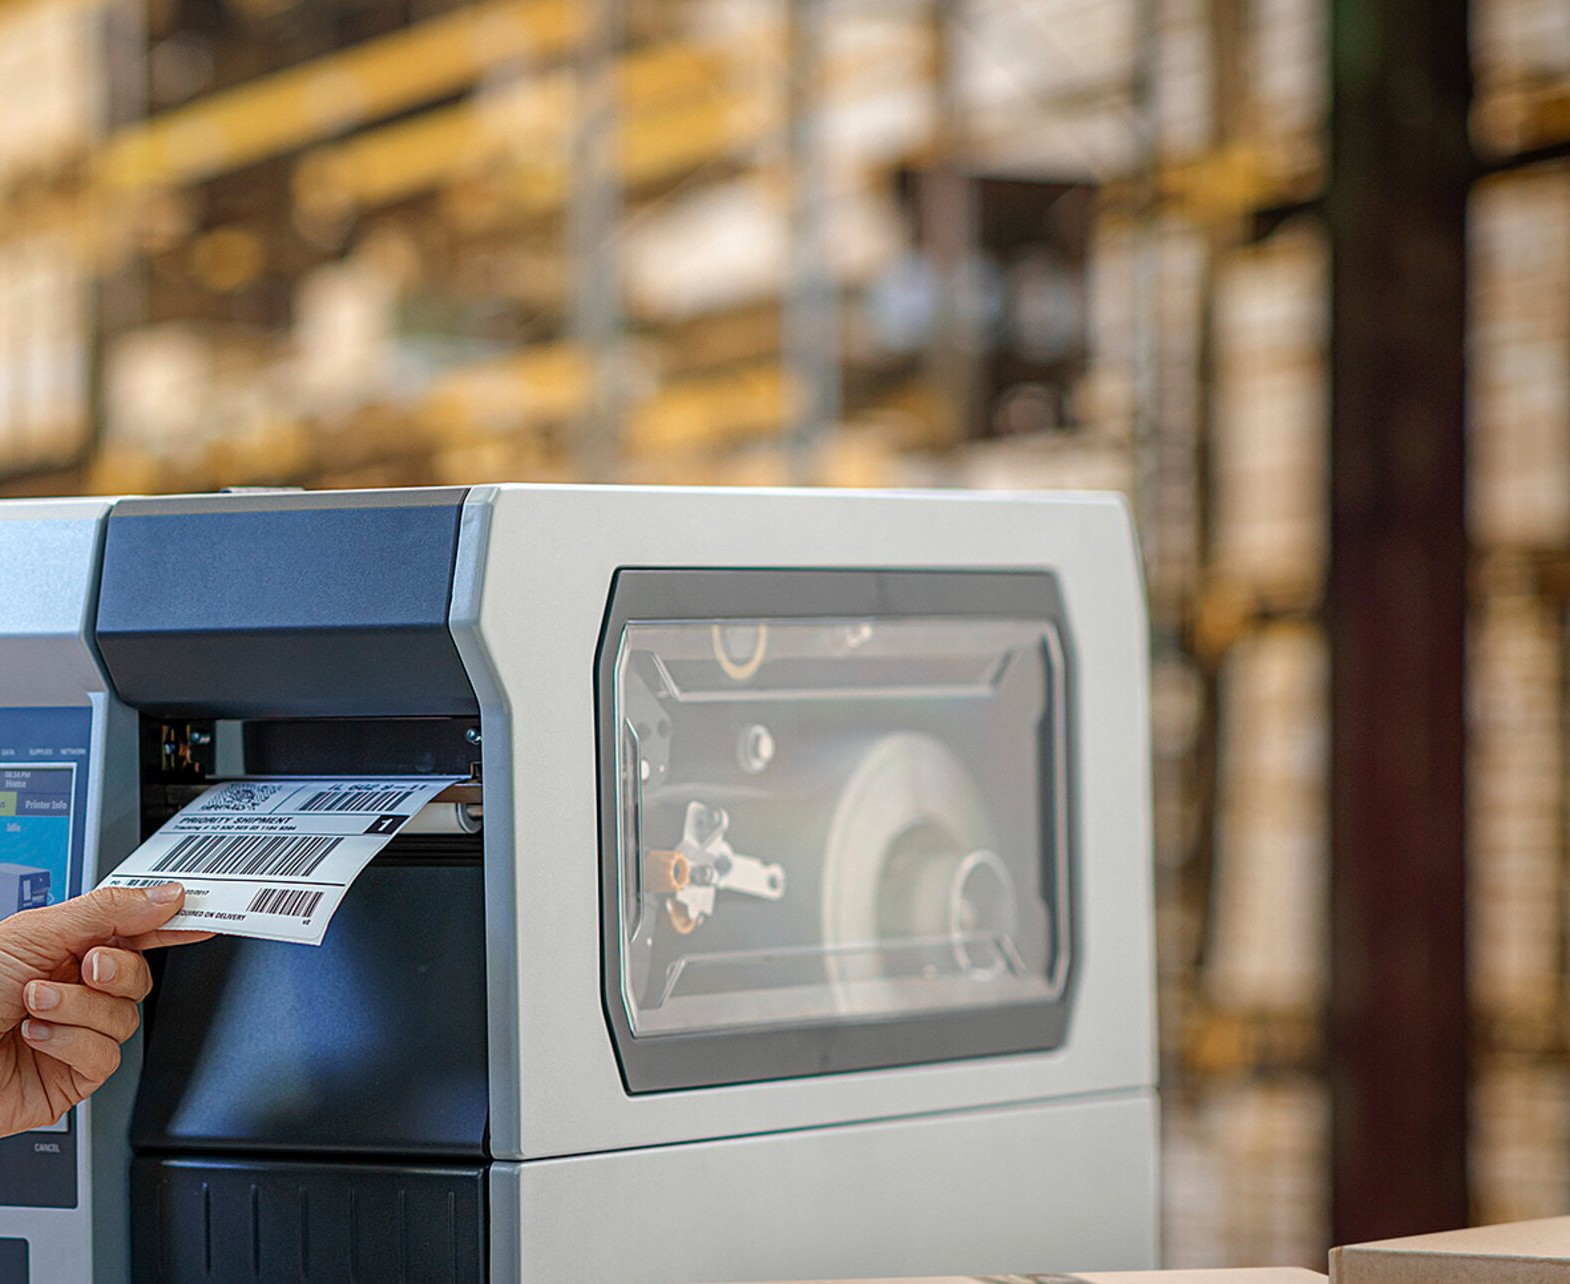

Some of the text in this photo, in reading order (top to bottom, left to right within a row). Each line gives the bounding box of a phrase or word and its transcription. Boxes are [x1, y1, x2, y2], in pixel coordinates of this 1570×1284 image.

[5, 780, 26, 788] Home
[25, 800, 68, 809] Printer Info
[378, 818, 394, 831] 1
[215, 912, 246, 921] DELIVERY
[34, 1143, 61, 1153] CANCEL
